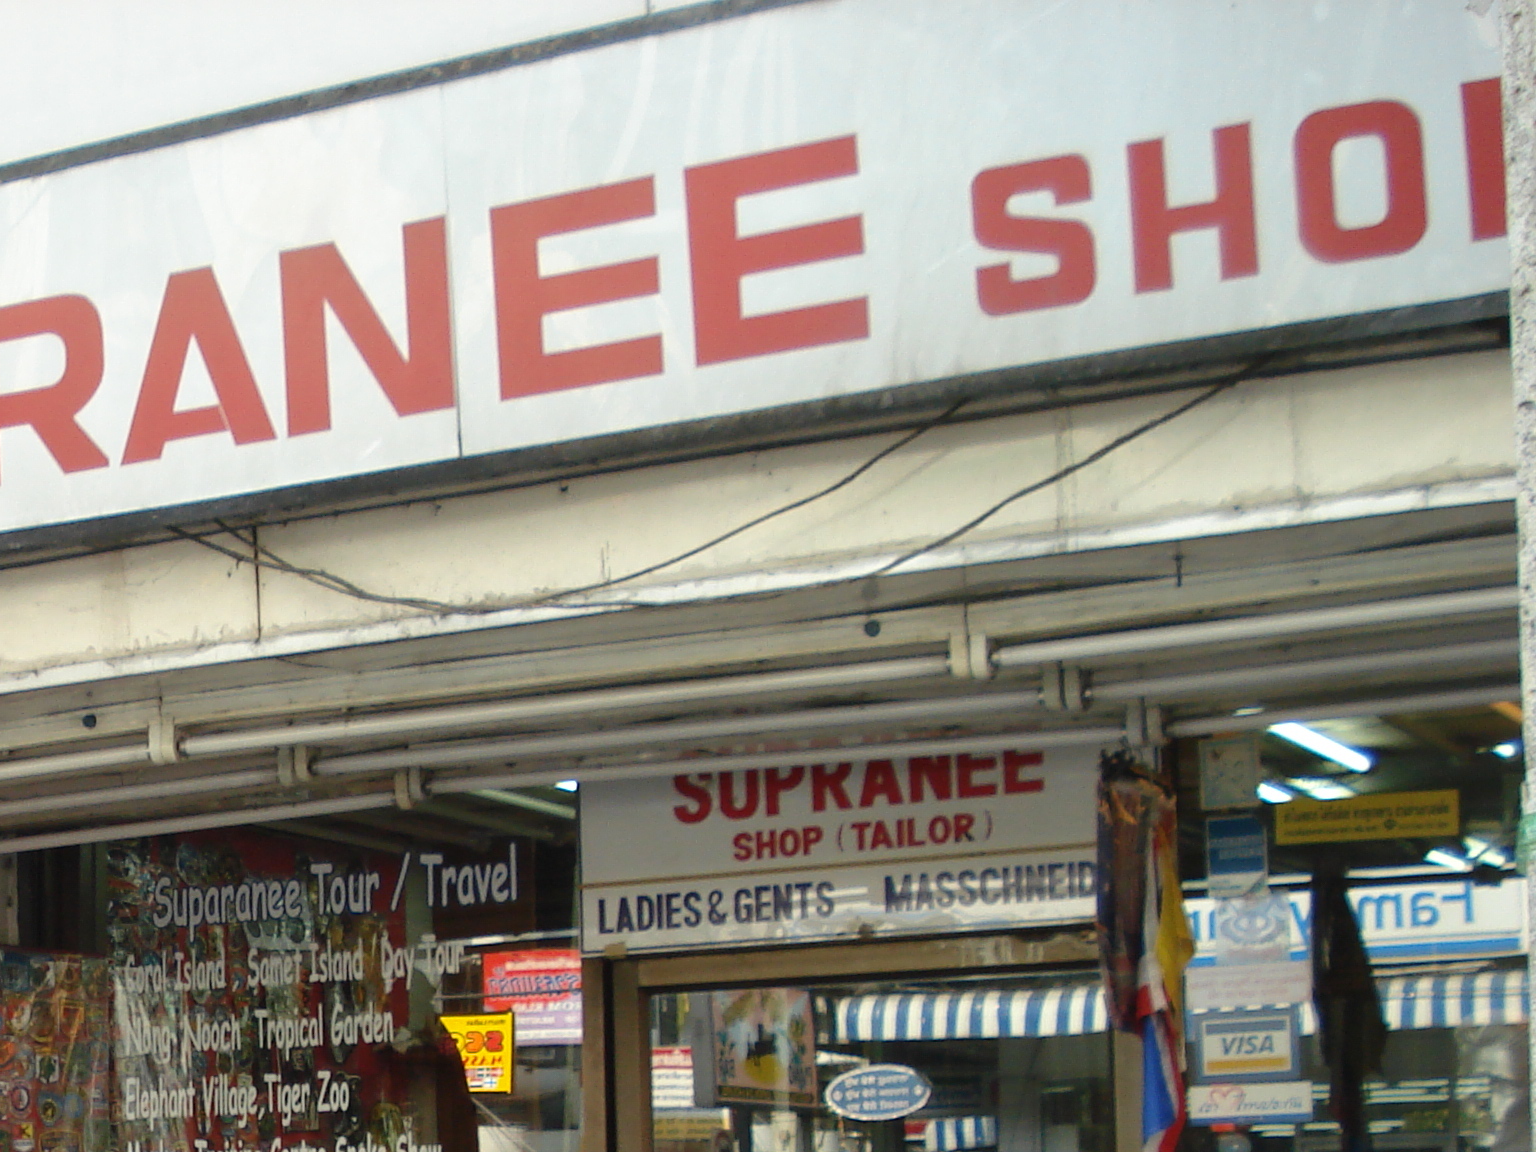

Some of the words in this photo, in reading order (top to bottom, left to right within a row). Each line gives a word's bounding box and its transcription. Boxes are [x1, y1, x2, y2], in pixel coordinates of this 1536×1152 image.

[672, 748, 1045, 824] SUPRANEE
[732, 827, 824, 860] SHOP
[153, 877, 303, 942] Suparanee
[311, 861, 379, 916] Tour
[420, 842, 517, 908] Travel
[598, 891, 702, 935] LADIES
[733, 881, 835, 925] GENTS
[247, 948, 303, 988] Samet
[309, 938, 364, 983] Island
[381, 934, 414, 990] Day
[417, 934, 464, 976] Tour
[126, 999, 176, 1064] Nong
[182, 1013, 242, 1058] Nooch
[255, 1003, 323, 1061] Tropical
[331, 1002, 394, 1046] Garden
[1220, 1034, 1275, 1056] VISA
[125, 1076, 195, 1128] Elephant
[318, 1070, 349, 1114] Zoo
